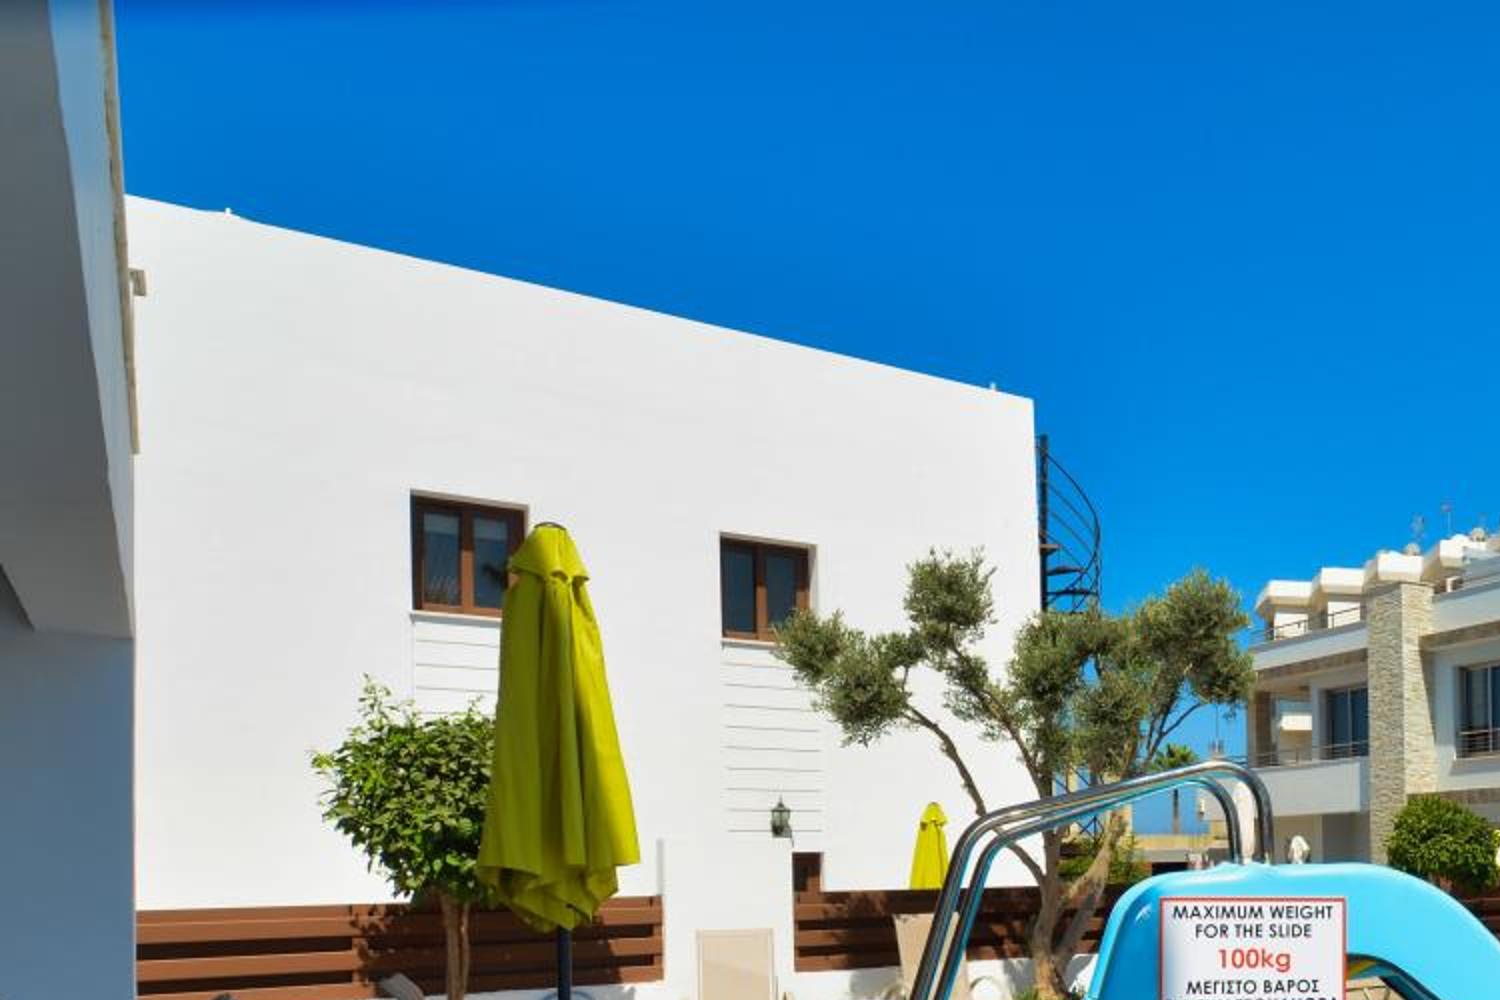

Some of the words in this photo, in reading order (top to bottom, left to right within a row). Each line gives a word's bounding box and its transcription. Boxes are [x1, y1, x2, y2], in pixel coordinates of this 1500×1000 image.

[1172, 905, 1264, 920] MAXIMUM
[1269, 905, 1333, 919] WEIGHT
[1195, 924, 1229, 939] FOR
[1234, 924, 1263, 938] THE
[1269, 924, 1313, 938] SLIDE
[1218, 949, 1292, 973] 100kg
[1186, 979, 1257, 995] ΜΕΓΙΣΤΟ
[1263, 979, 1320, 994] ΒΑΡΟΣ
